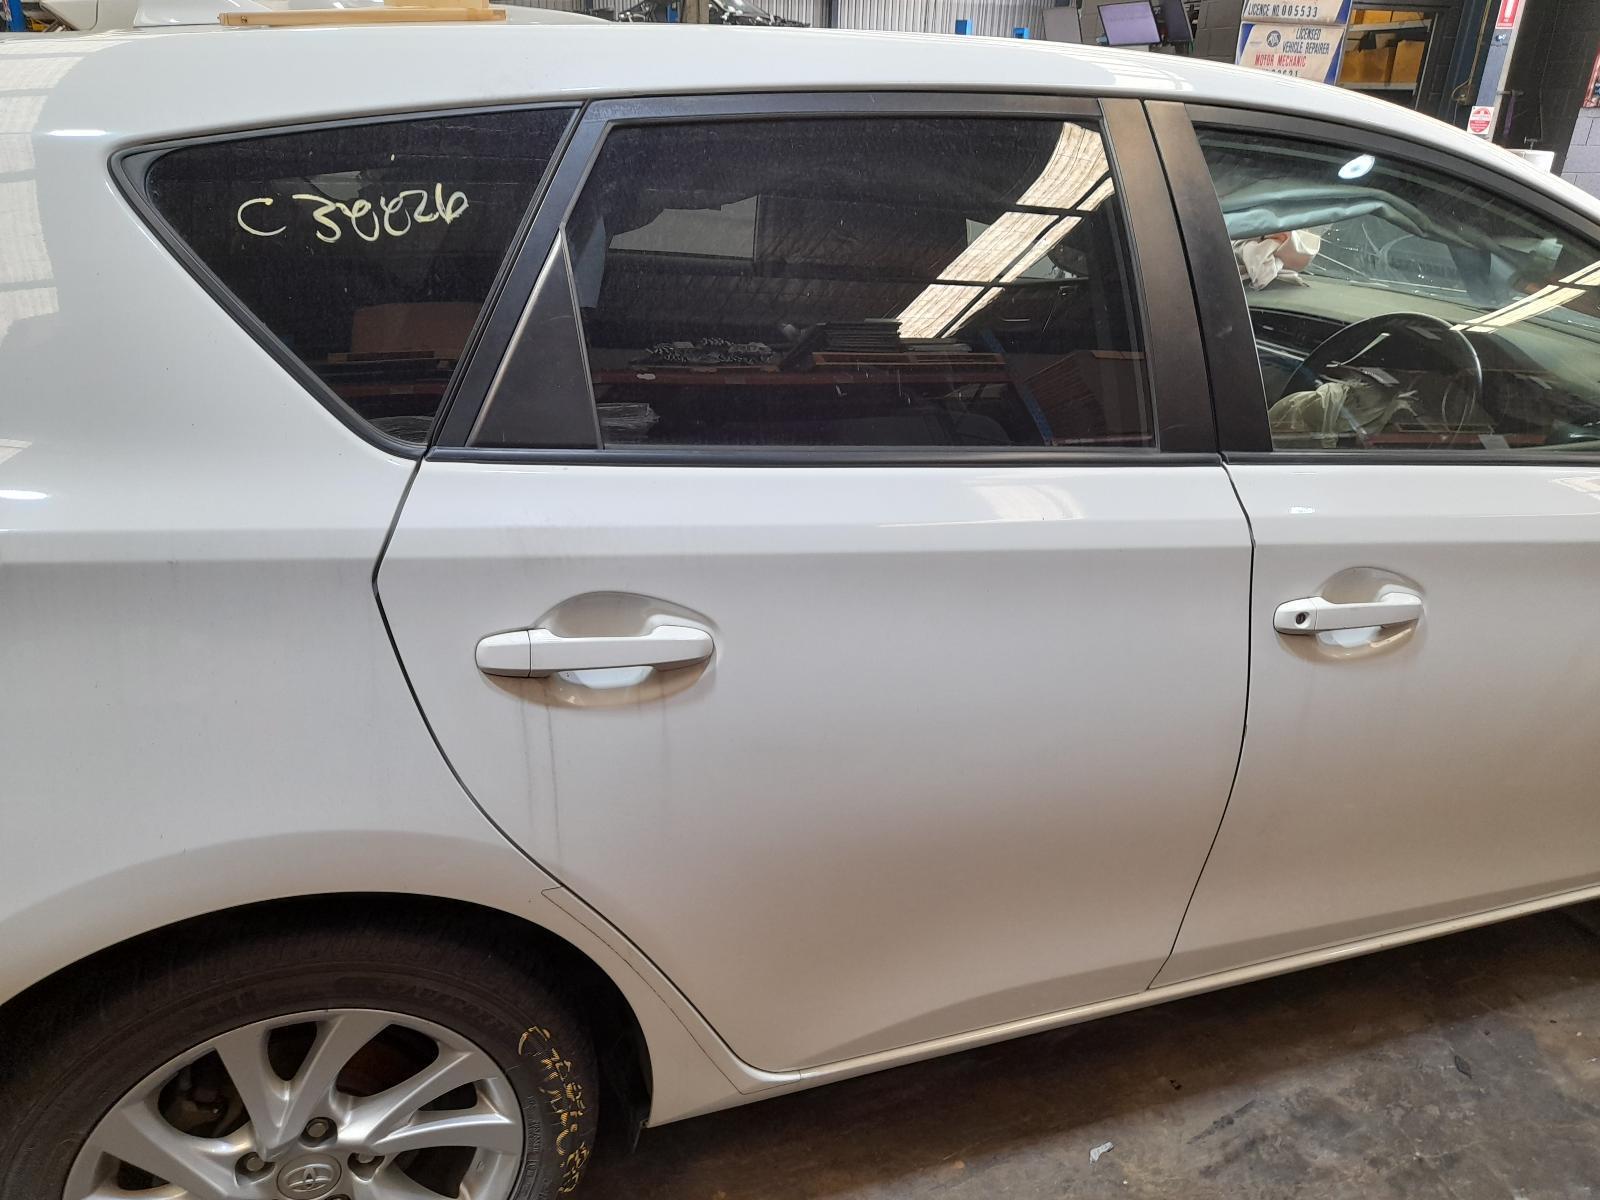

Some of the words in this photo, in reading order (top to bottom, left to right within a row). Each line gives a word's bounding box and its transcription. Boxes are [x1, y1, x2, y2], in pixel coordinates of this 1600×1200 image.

[1248, 3, 1270, 16] LICENCE
[1281, 5, 1318, 18] 005533
[1295, 27, 1322, 41] LICENSED
[1282, 41, 1304, 54] VEHICLE
[1304, 42, 1330, 55] REPAIRER
[1254, 54, 1275, 66] MOTOR
[1277, 55, 1307, 68] MECHANIC
